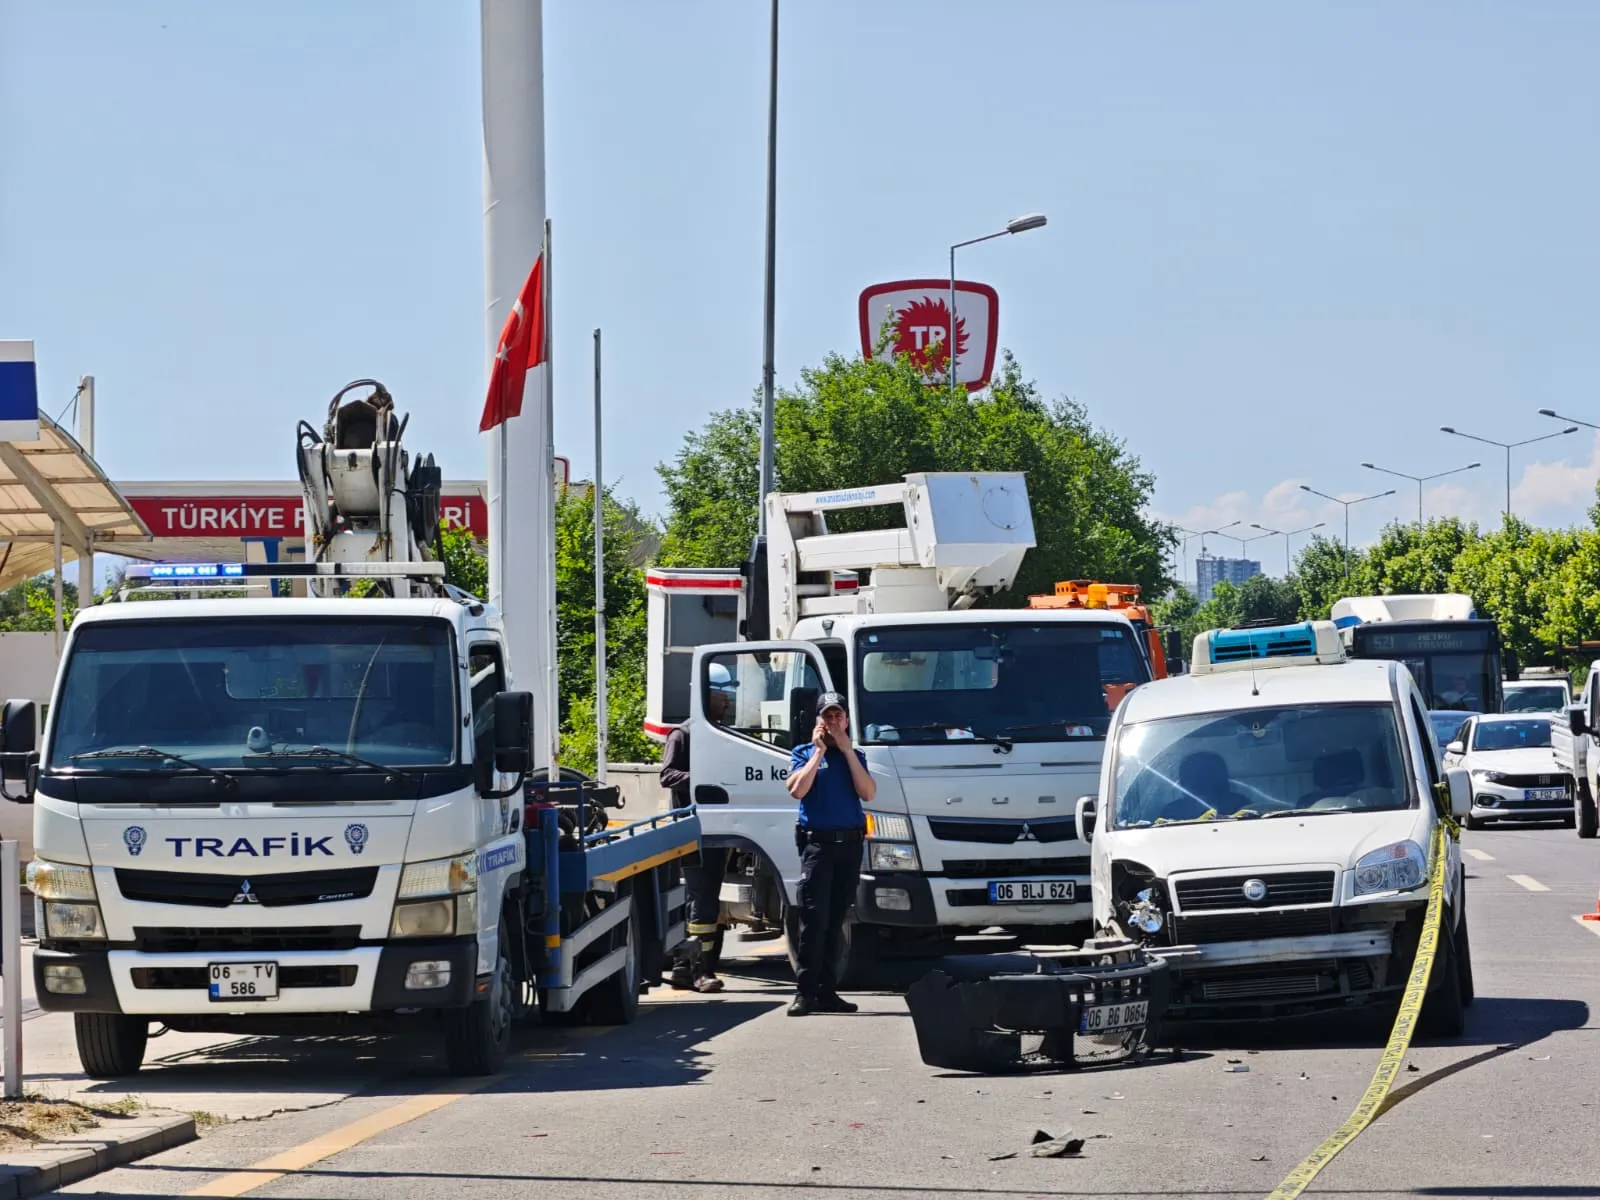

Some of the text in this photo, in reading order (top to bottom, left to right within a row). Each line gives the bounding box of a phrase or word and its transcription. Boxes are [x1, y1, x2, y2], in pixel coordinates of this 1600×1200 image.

[161, 503, 284, 529] TÜRKİYE
[165, 832, 335, 857] TRAFİK
[998, 883, 1072, 899] 06 BLJ 624
[212, 965, 273, 979] 06 TV
[231, 982, 256, 995] 586
[1088, 1009, 1102, 1028] 06
[1124, 1003, 1147, 1024] 0864
